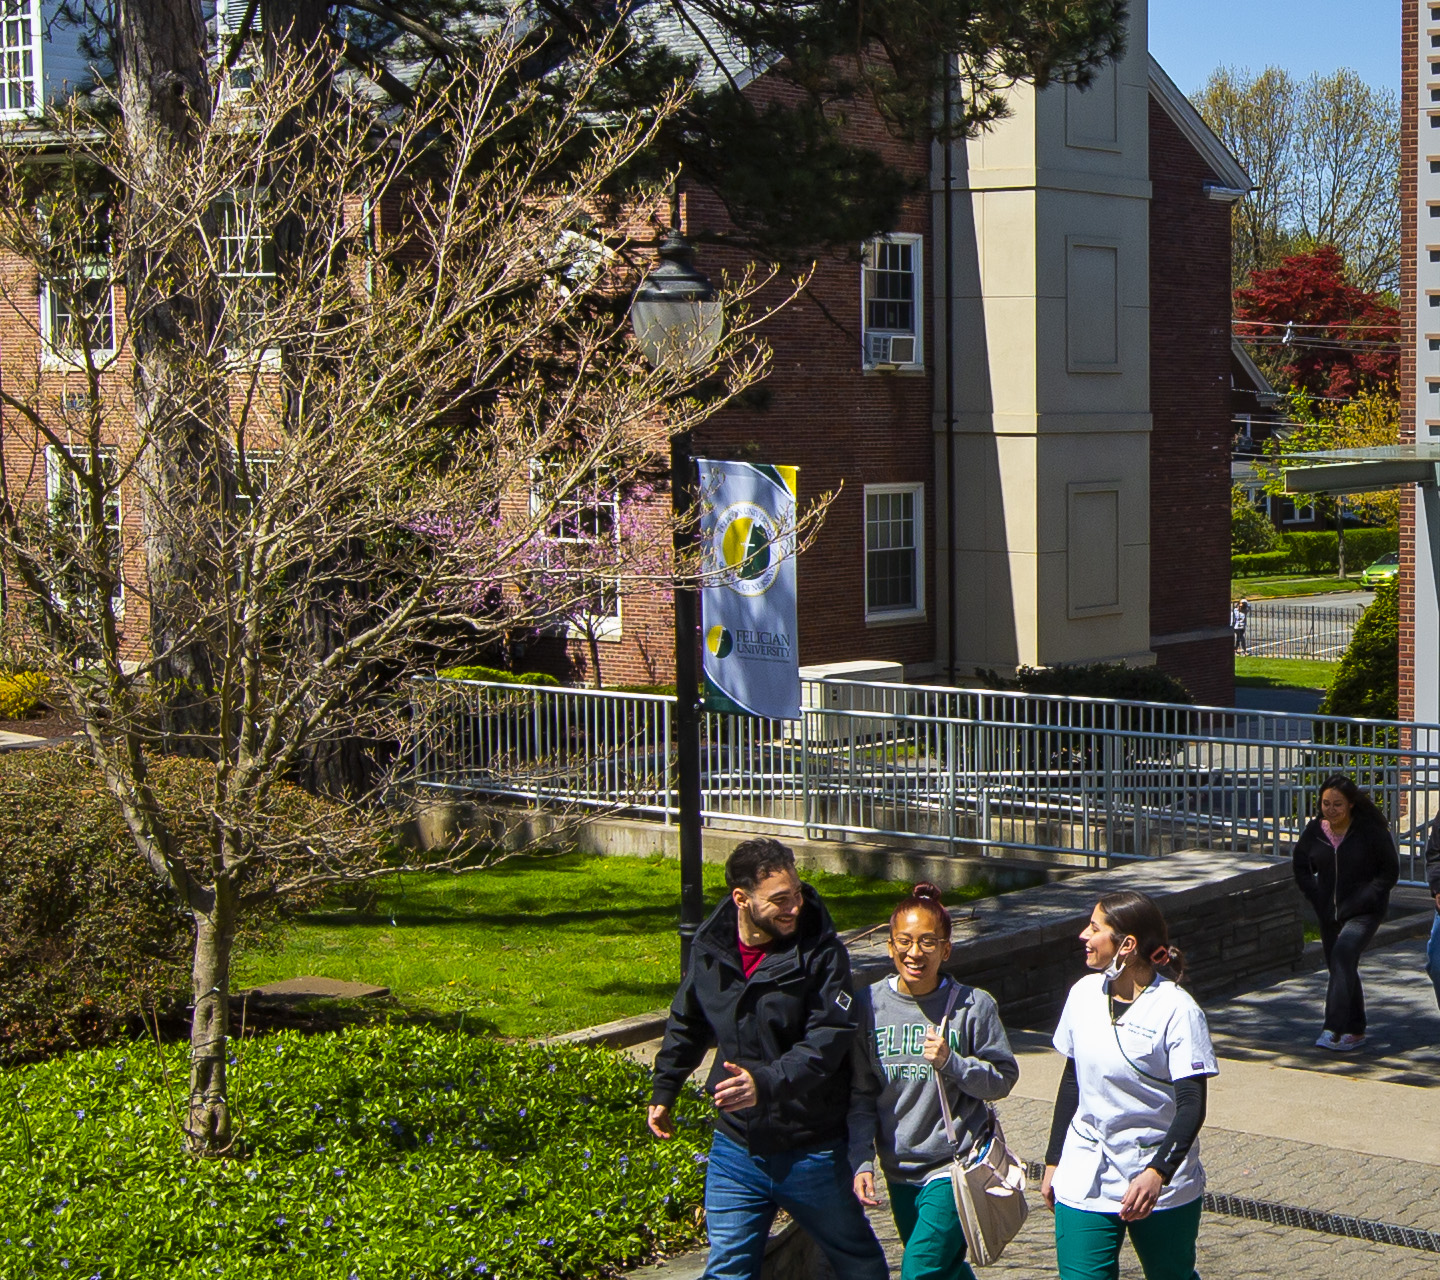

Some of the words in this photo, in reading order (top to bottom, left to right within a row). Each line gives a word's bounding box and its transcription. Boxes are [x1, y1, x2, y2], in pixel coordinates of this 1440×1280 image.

[736, 629, 790, 647] FELICIAN
[737, 642, 791, 658] UNIVERSITY
[870, 1023, 962, 1059] ELICN
